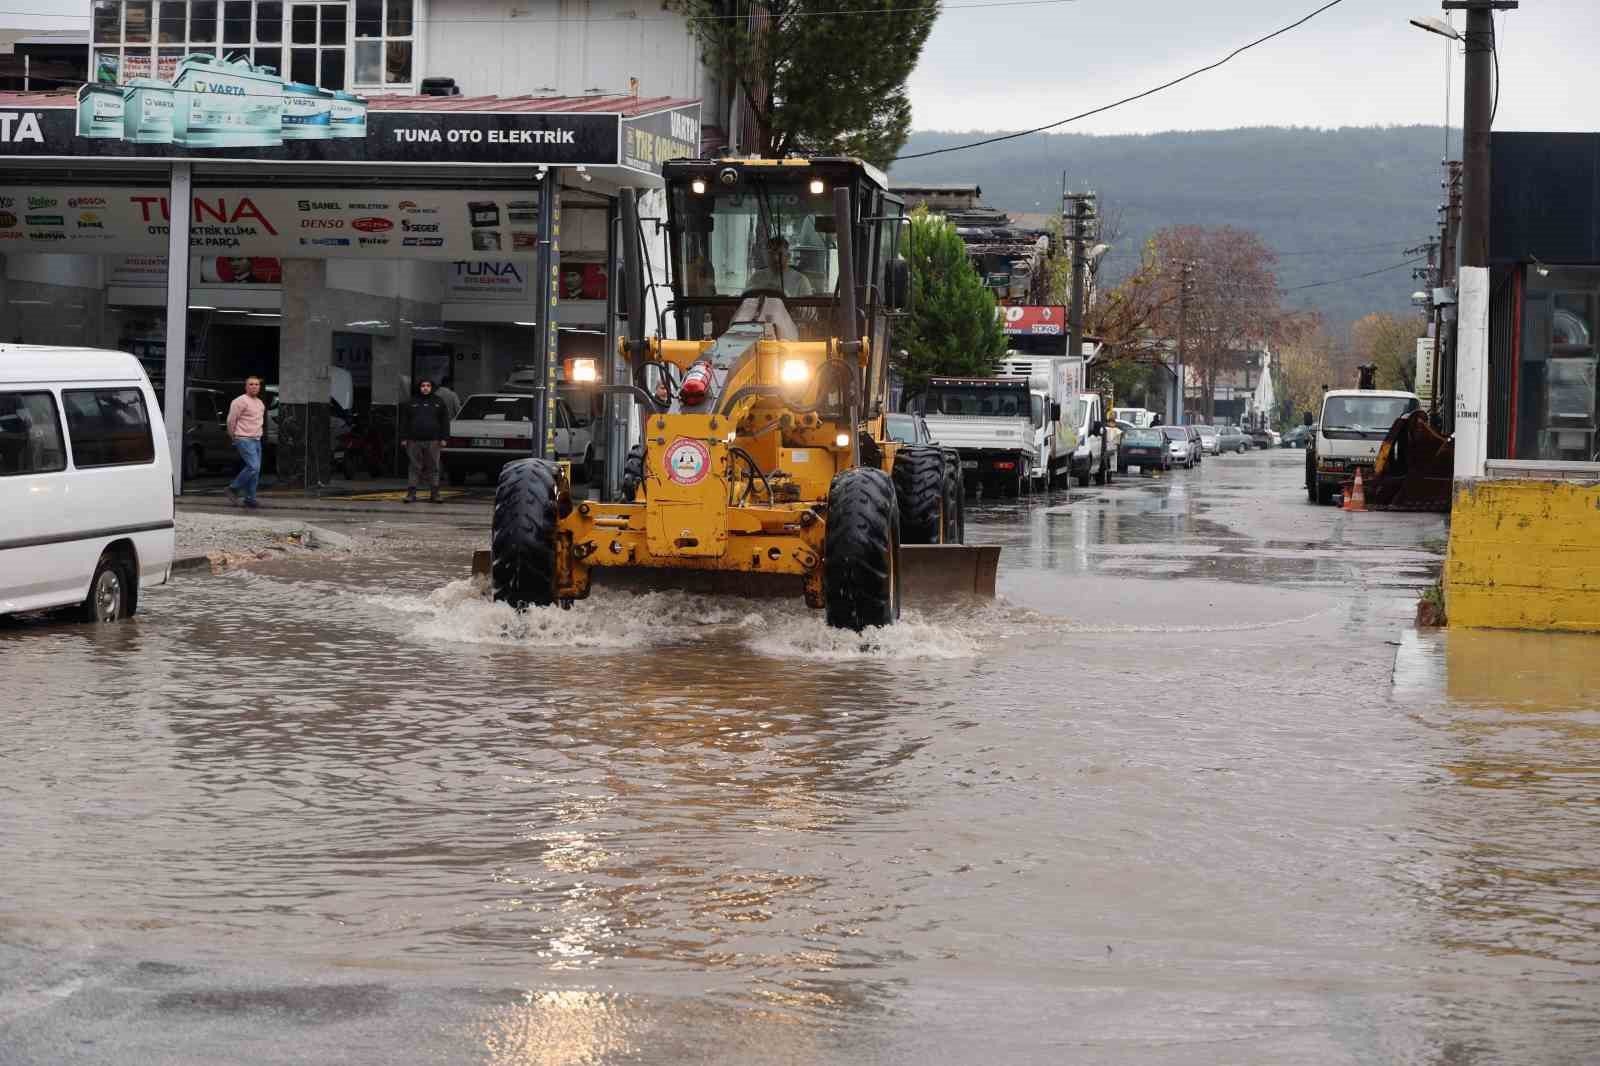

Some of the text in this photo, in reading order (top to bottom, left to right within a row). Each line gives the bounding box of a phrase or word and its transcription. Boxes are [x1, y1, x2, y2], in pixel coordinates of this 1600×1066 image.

[209, 83, 246, 96] VARTA
[393, 127, 576, 144] TUNA OTO ELEKTRİK
[635, 128, 654, 162] THE
[301, 218, 345, 229] DENSO
[411, 224, 439, 233] SEGER
[551, 193, 561, 252] TUNA
[224, 225, 257, 236] KLİMA
[206, 238, 241, 249] PARÇA
[452, 261, 522, 283] TUNA
[550, 265, 560, 307] OTO
